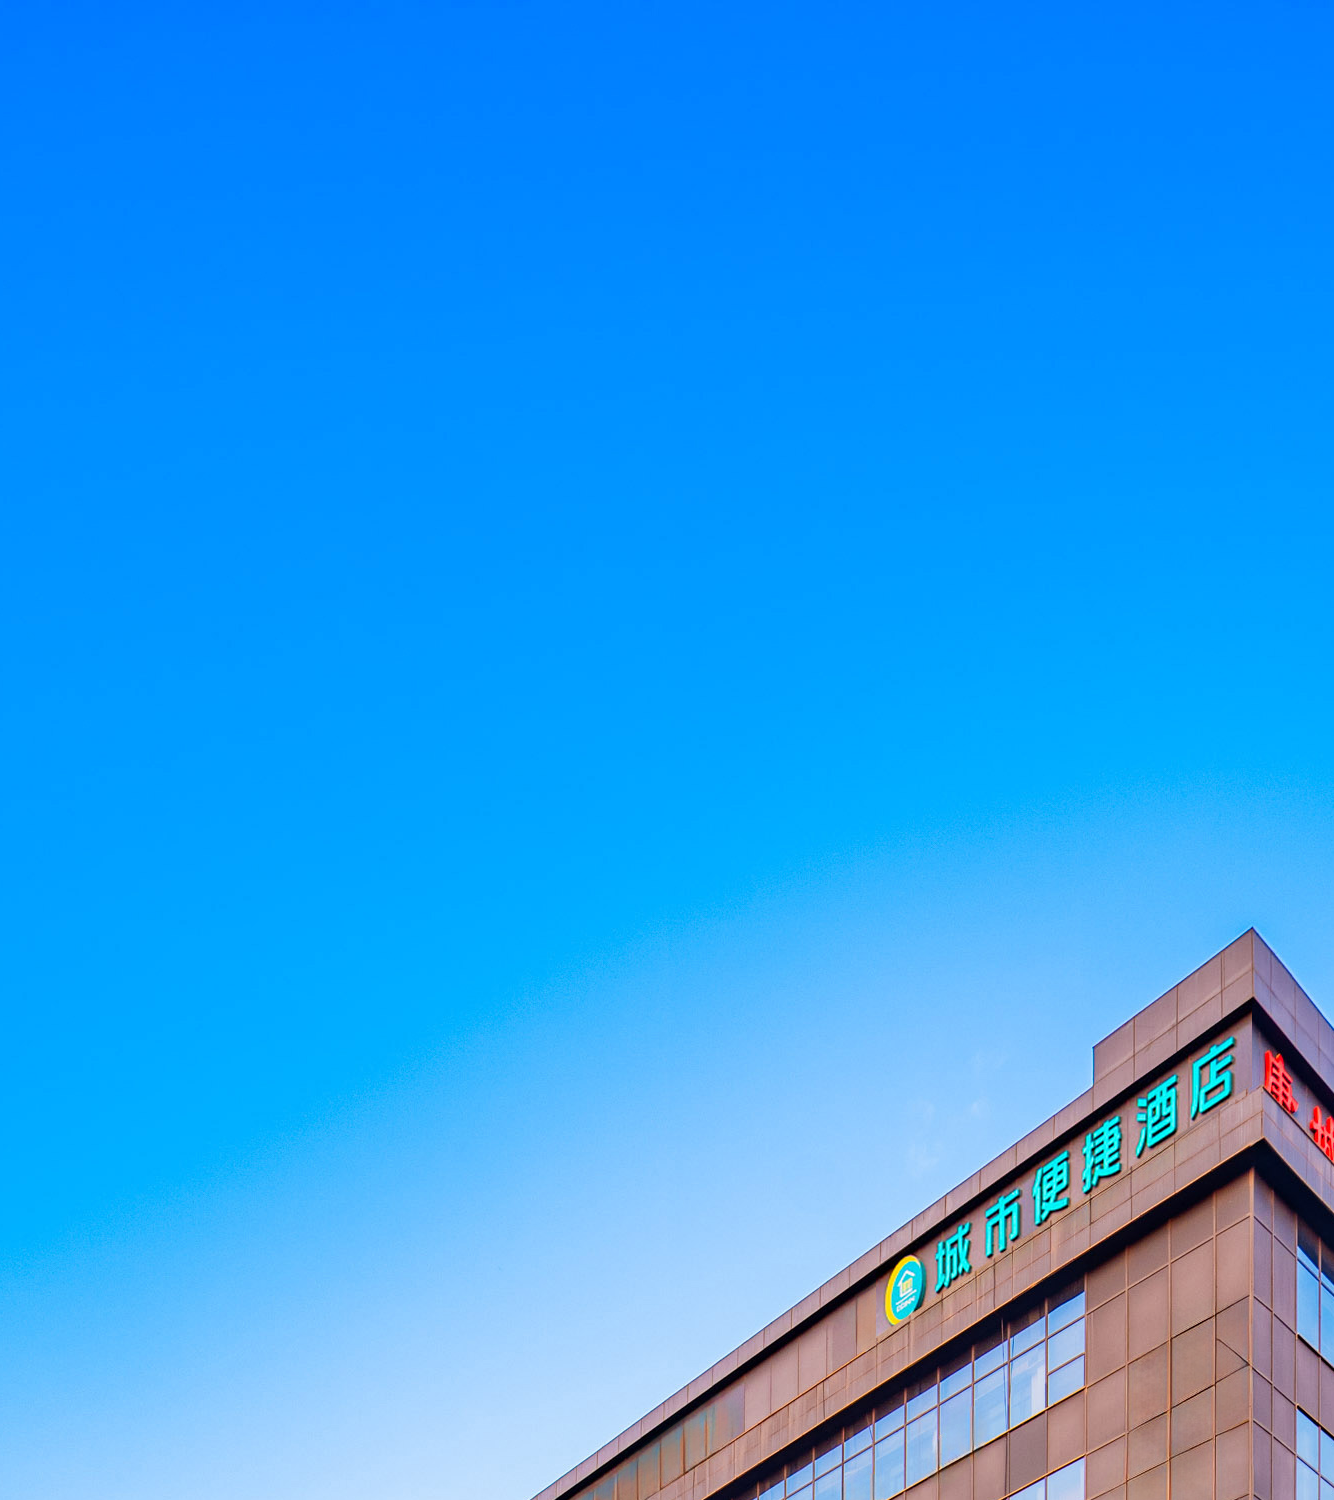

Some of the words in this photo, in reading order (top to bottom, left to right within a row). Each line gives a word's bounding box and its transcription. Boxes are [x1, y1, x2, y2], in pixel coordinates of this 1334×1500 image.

[934, 1036, 1235, 1293] 城市便捷酒店
